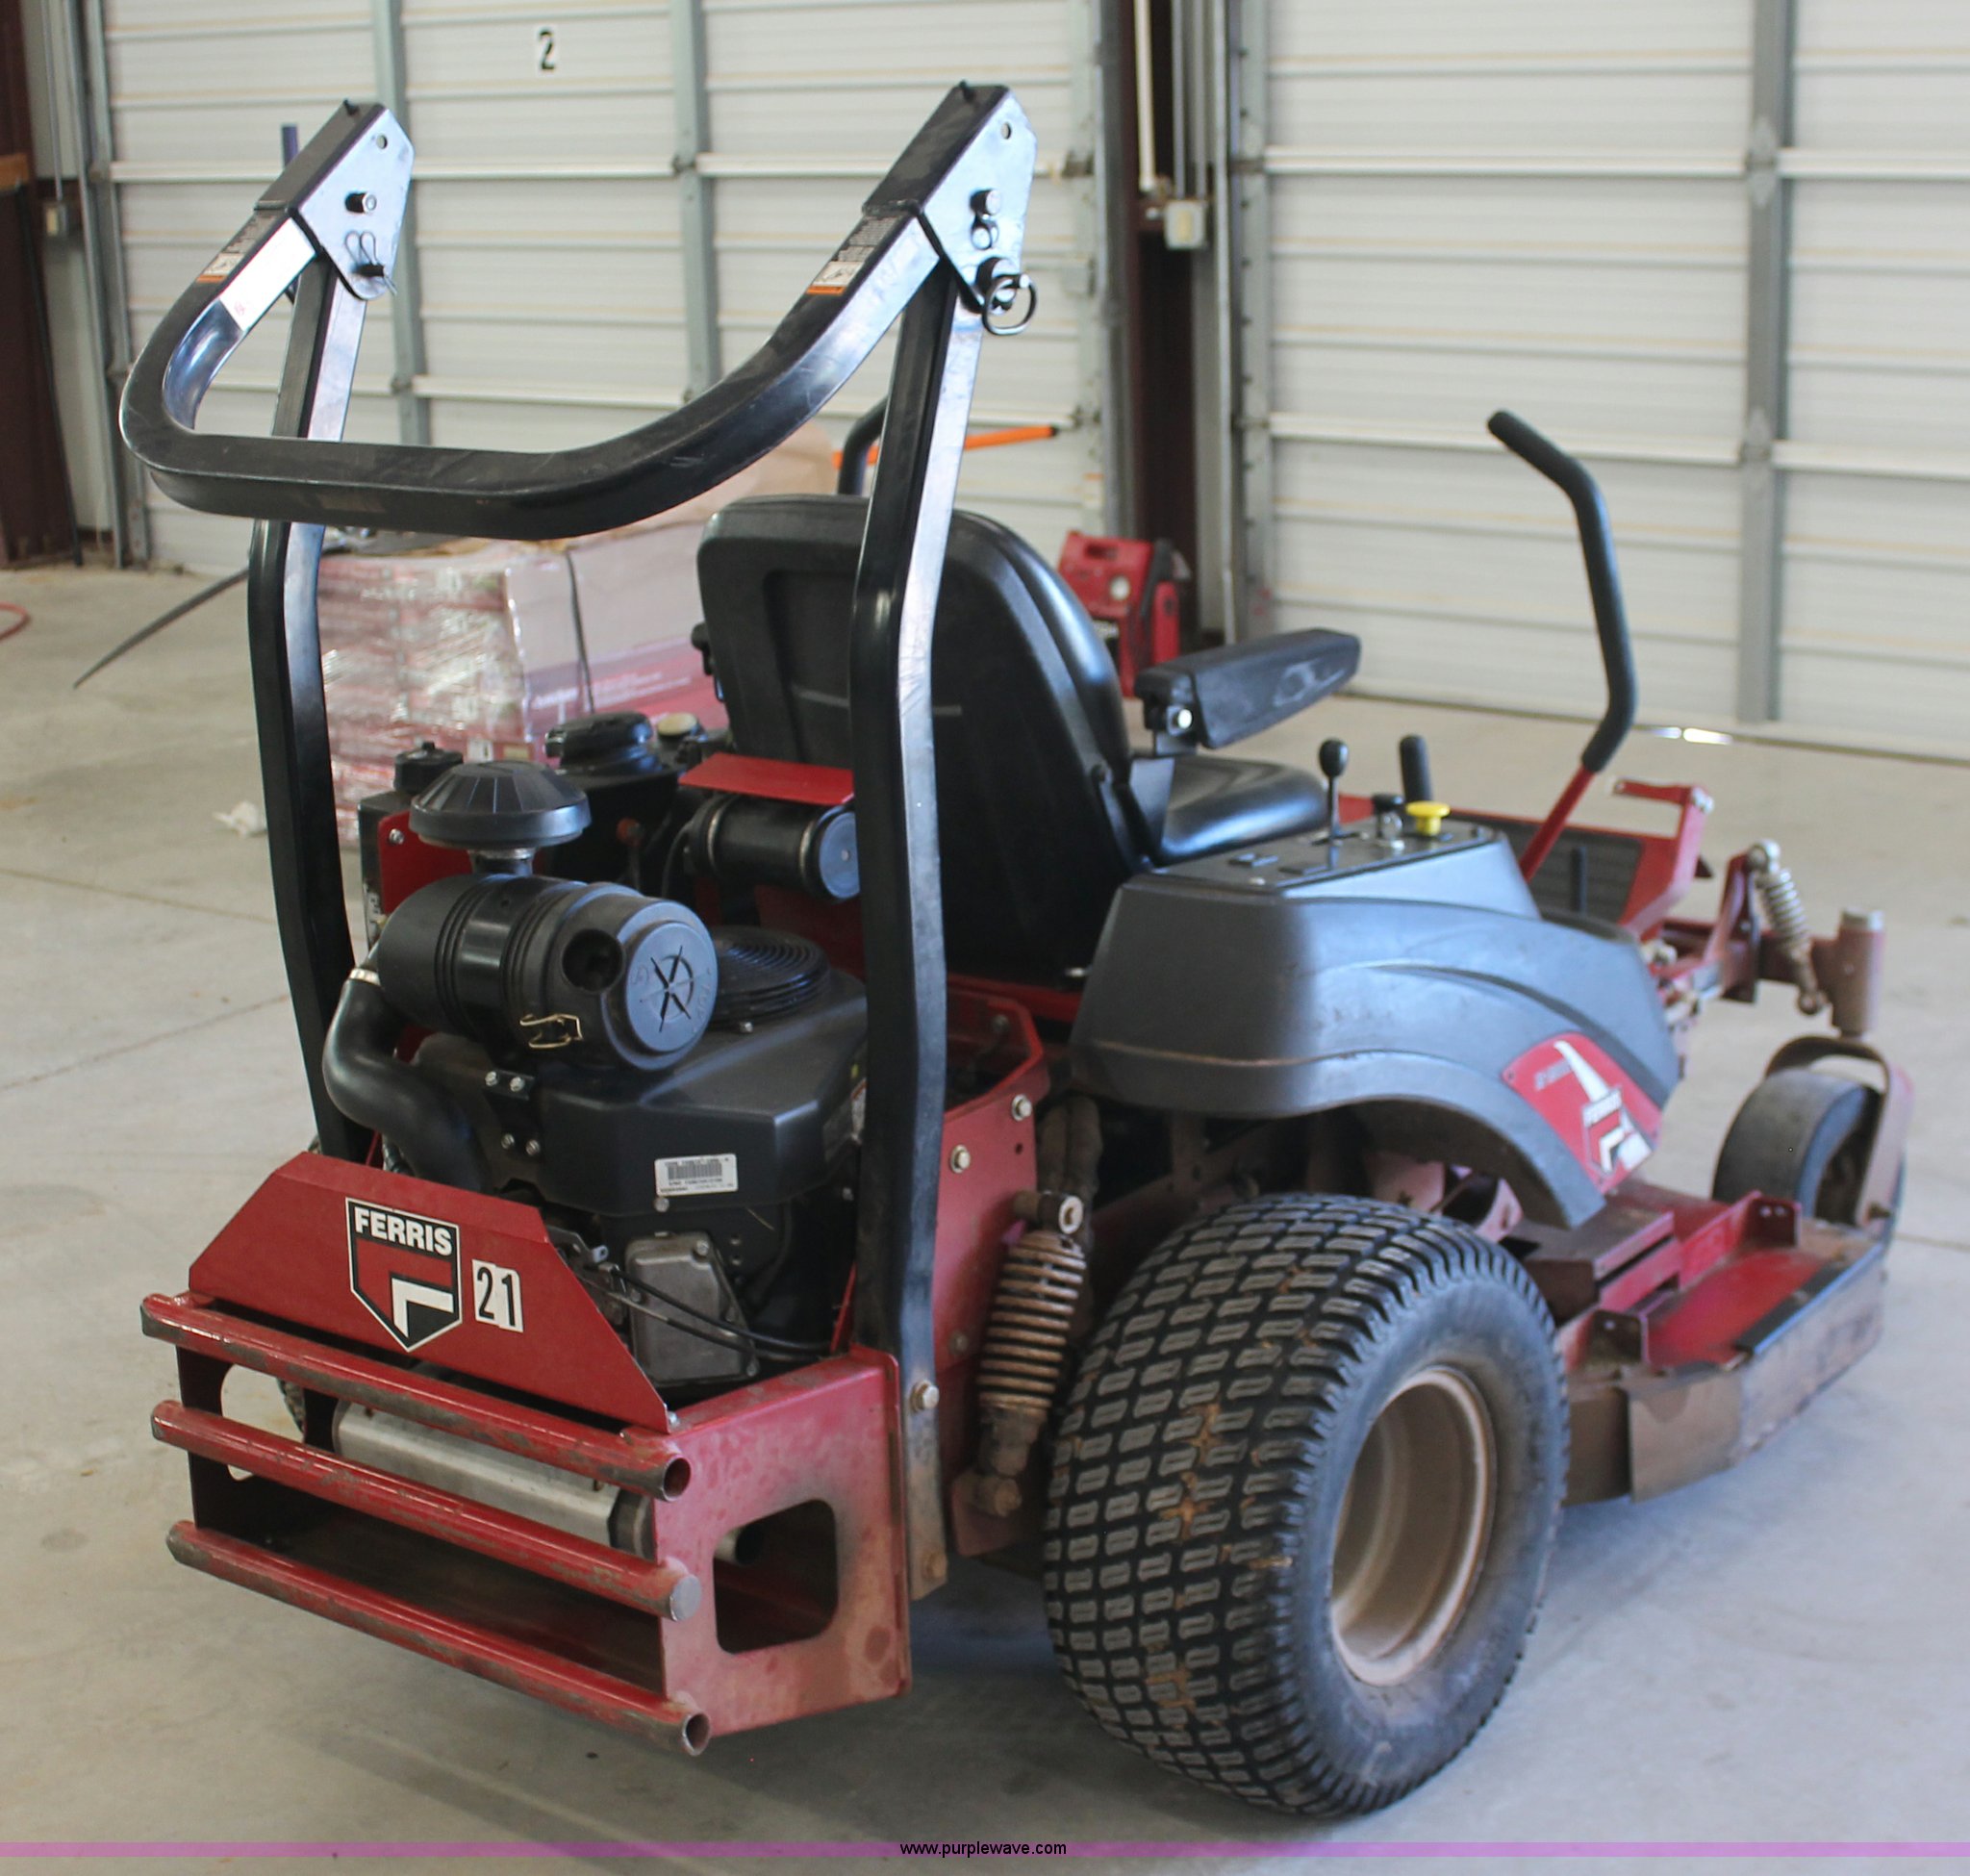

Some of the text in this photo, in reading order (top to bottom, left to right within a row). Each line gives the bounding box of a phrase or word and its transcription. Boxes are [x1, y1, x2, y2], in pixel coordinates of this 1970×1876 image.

[539, 30, 555, 71] 2
[354, 1206, 452, 1255] FERRIS
[476, 1266, 517, 1328] 21
